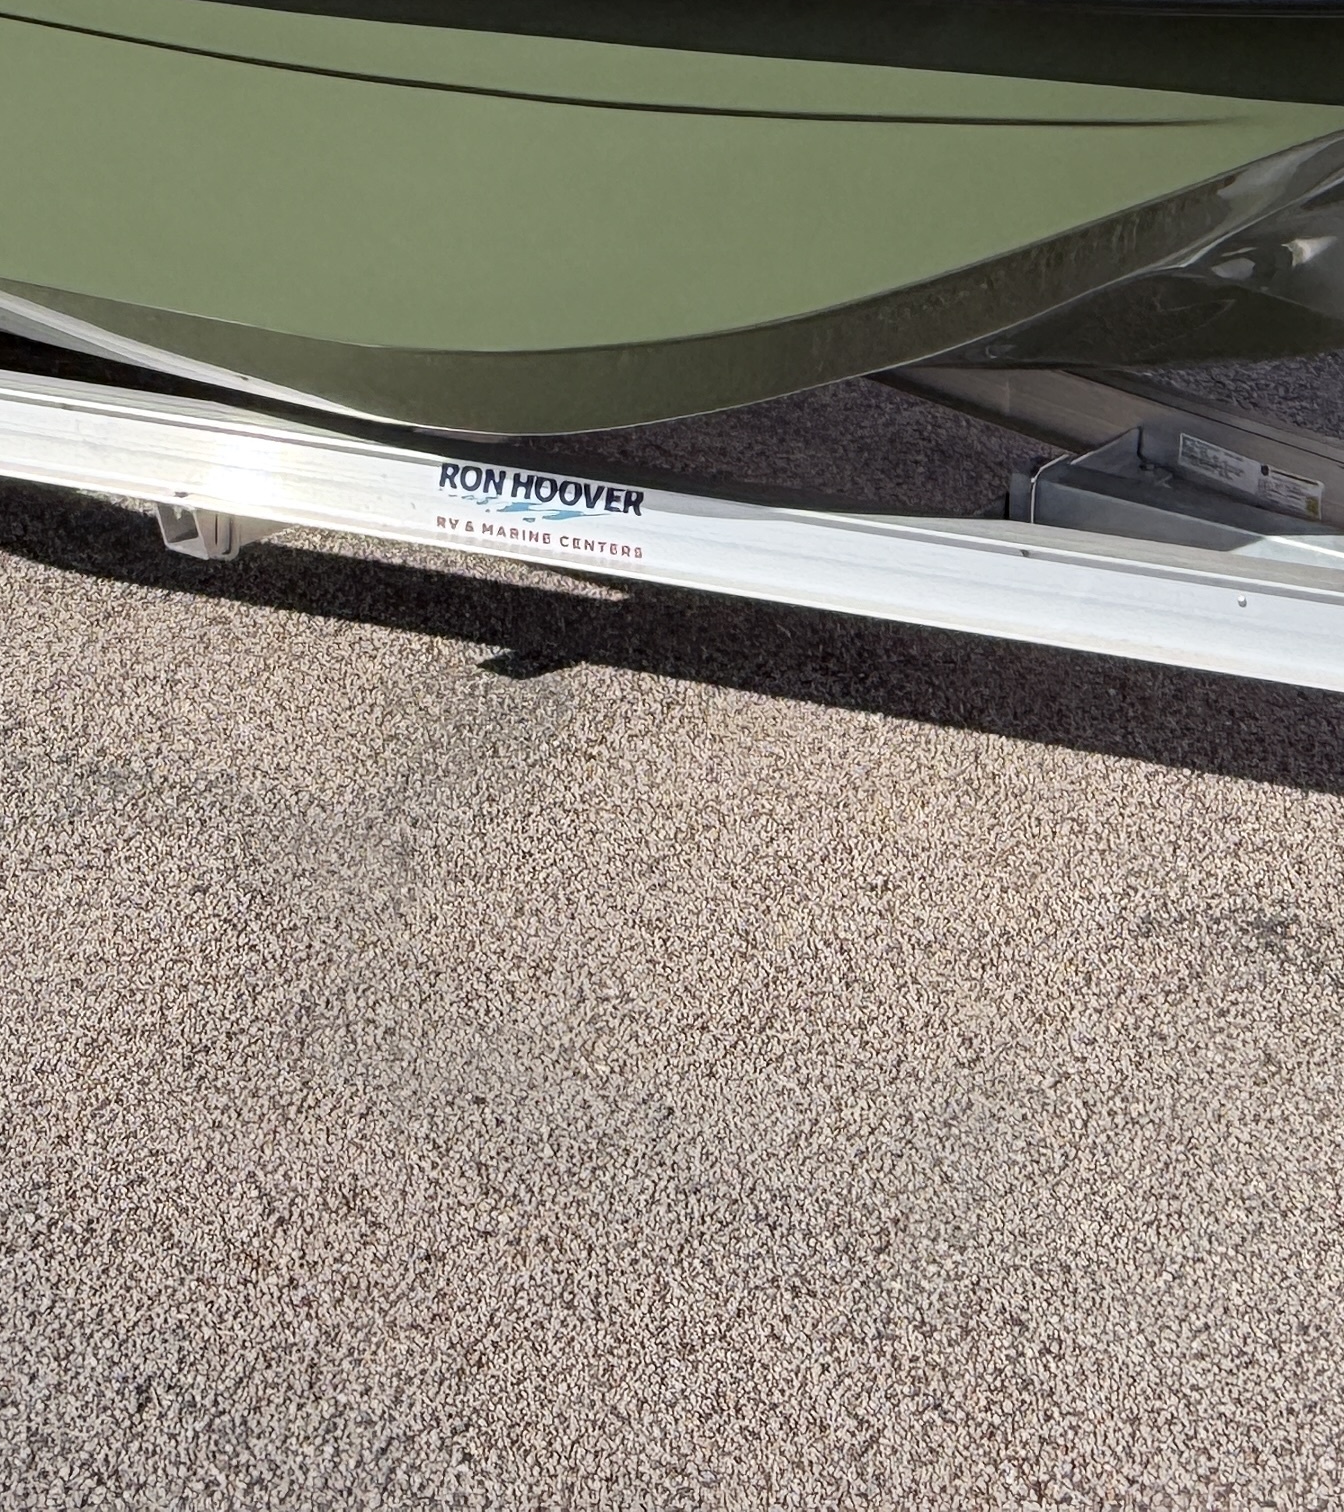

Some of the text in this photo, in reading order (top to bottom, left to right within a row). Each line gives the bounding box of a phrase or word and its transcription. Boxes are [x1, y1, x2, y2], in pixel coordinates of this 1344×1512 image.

[439, 462, 644, 516] RON HOOVER
[436, 516, 459, 530] RV
[481, 524, 552, 545] MARINE
[559, 536, 644, 559] CENTERS
